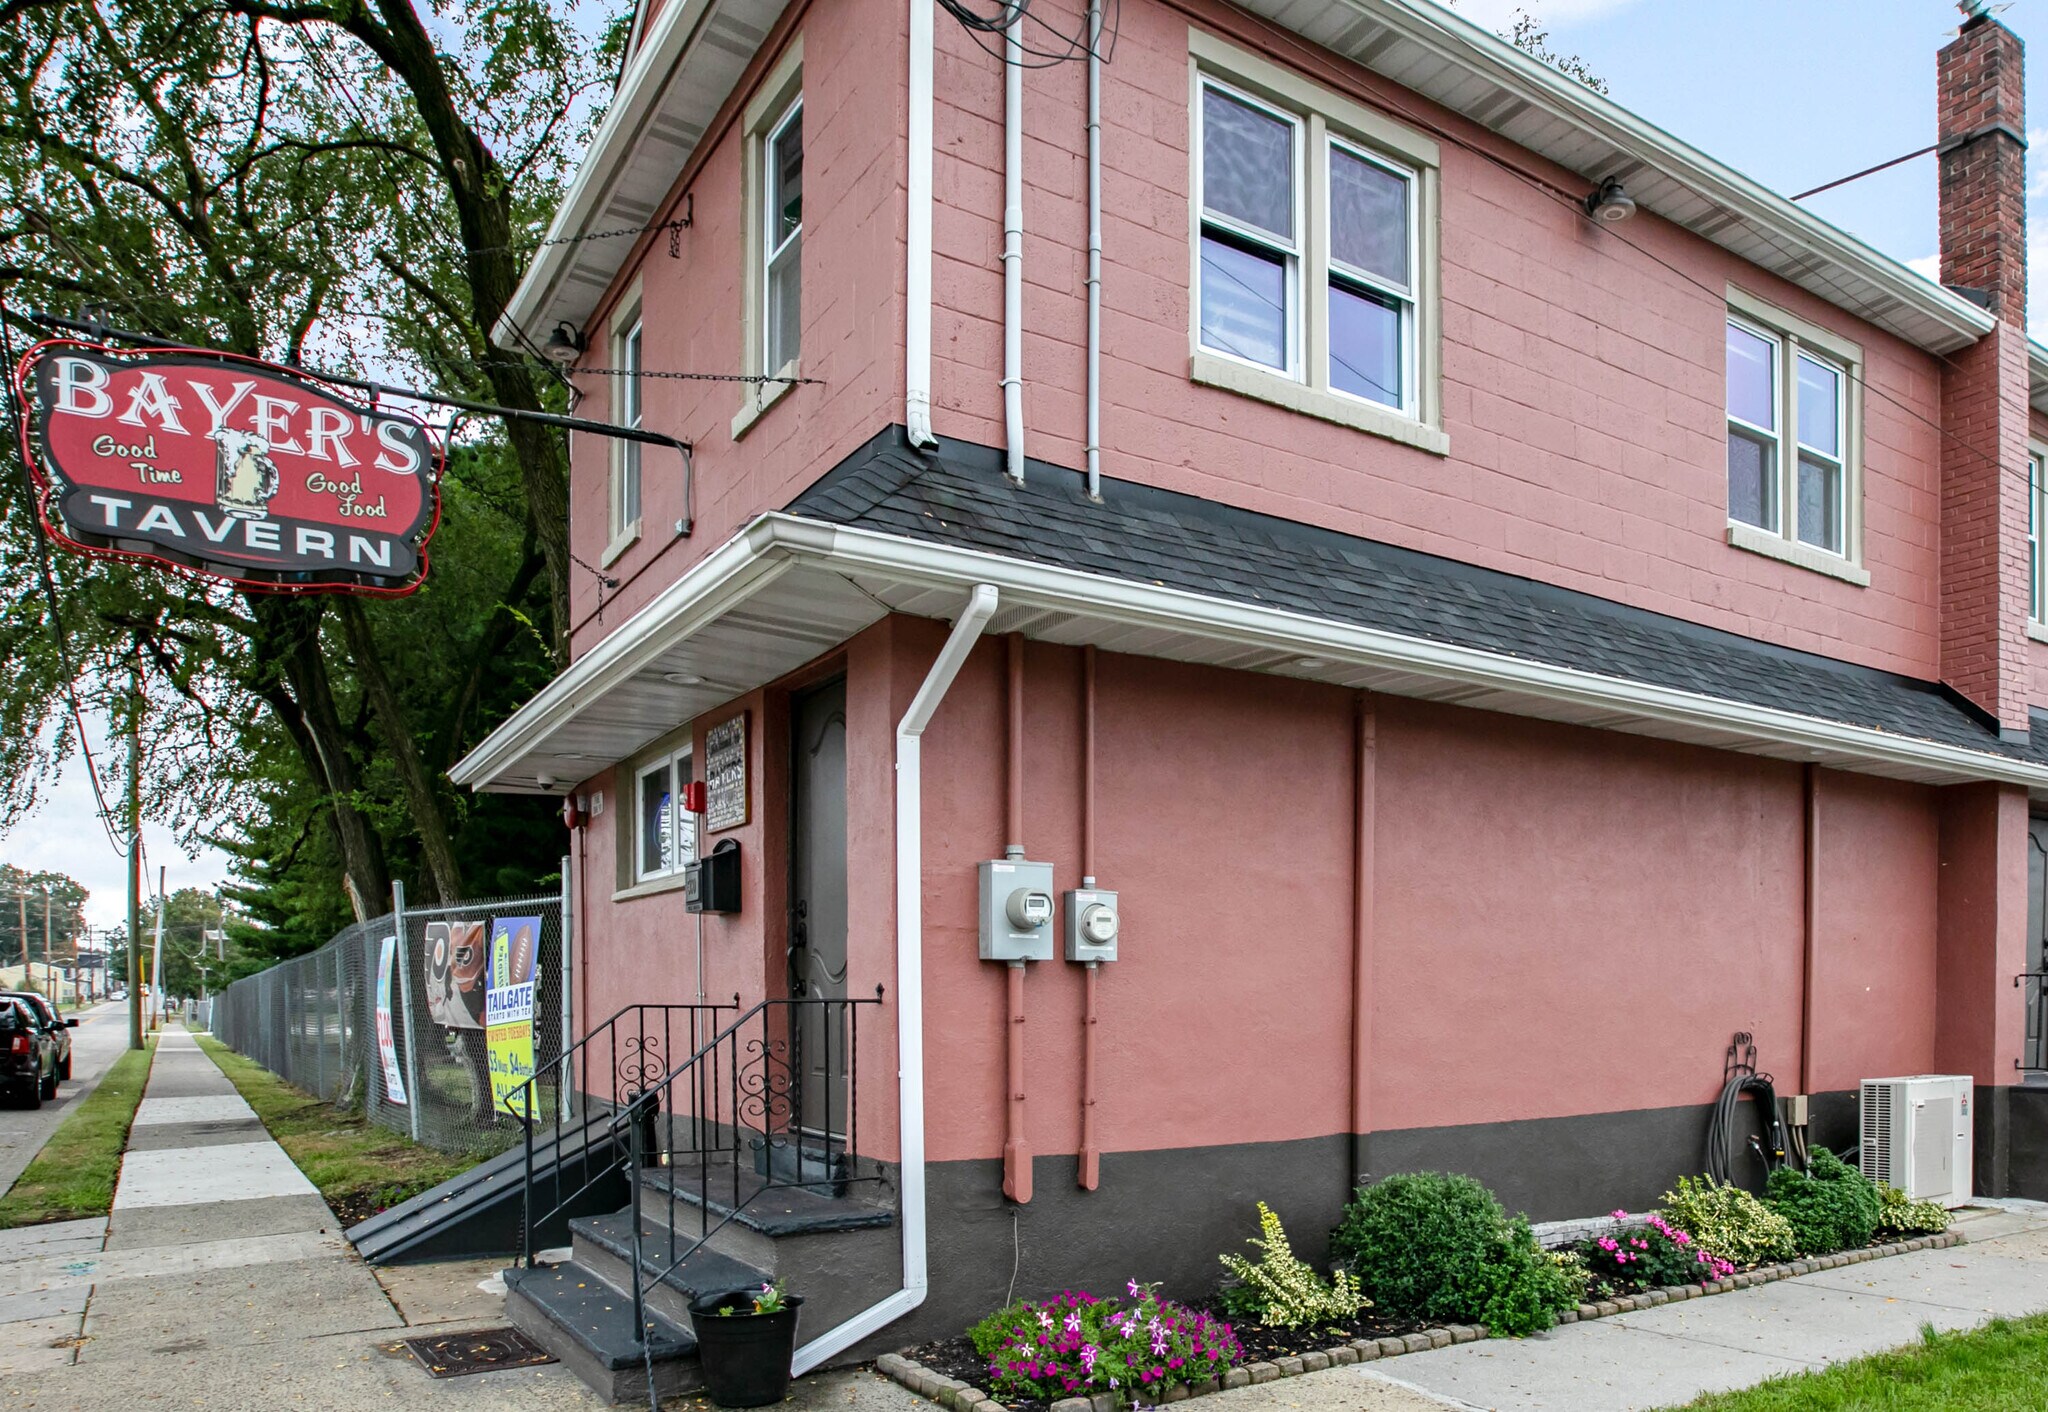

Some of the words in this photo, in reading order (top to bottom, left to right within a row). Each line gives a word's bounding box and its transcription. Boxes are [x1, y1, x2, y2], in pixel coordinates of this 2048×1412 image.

[51, 356, 421, 475] BAYER'S
[91, 434, 158, 460] Good
[130, 462, 183, 484] Time
[305, 472, 364, 495] Good
[338, 494, 388, 518] Food
[90, 494, 391, 568] TAVERN
[488, 986, 532, 1012] TAILGATE
[488, 1011, 505, 1021] STARTS
[507, 1009, 520, 1018] WITH
[521, 1007, 531, 1016] TEA
